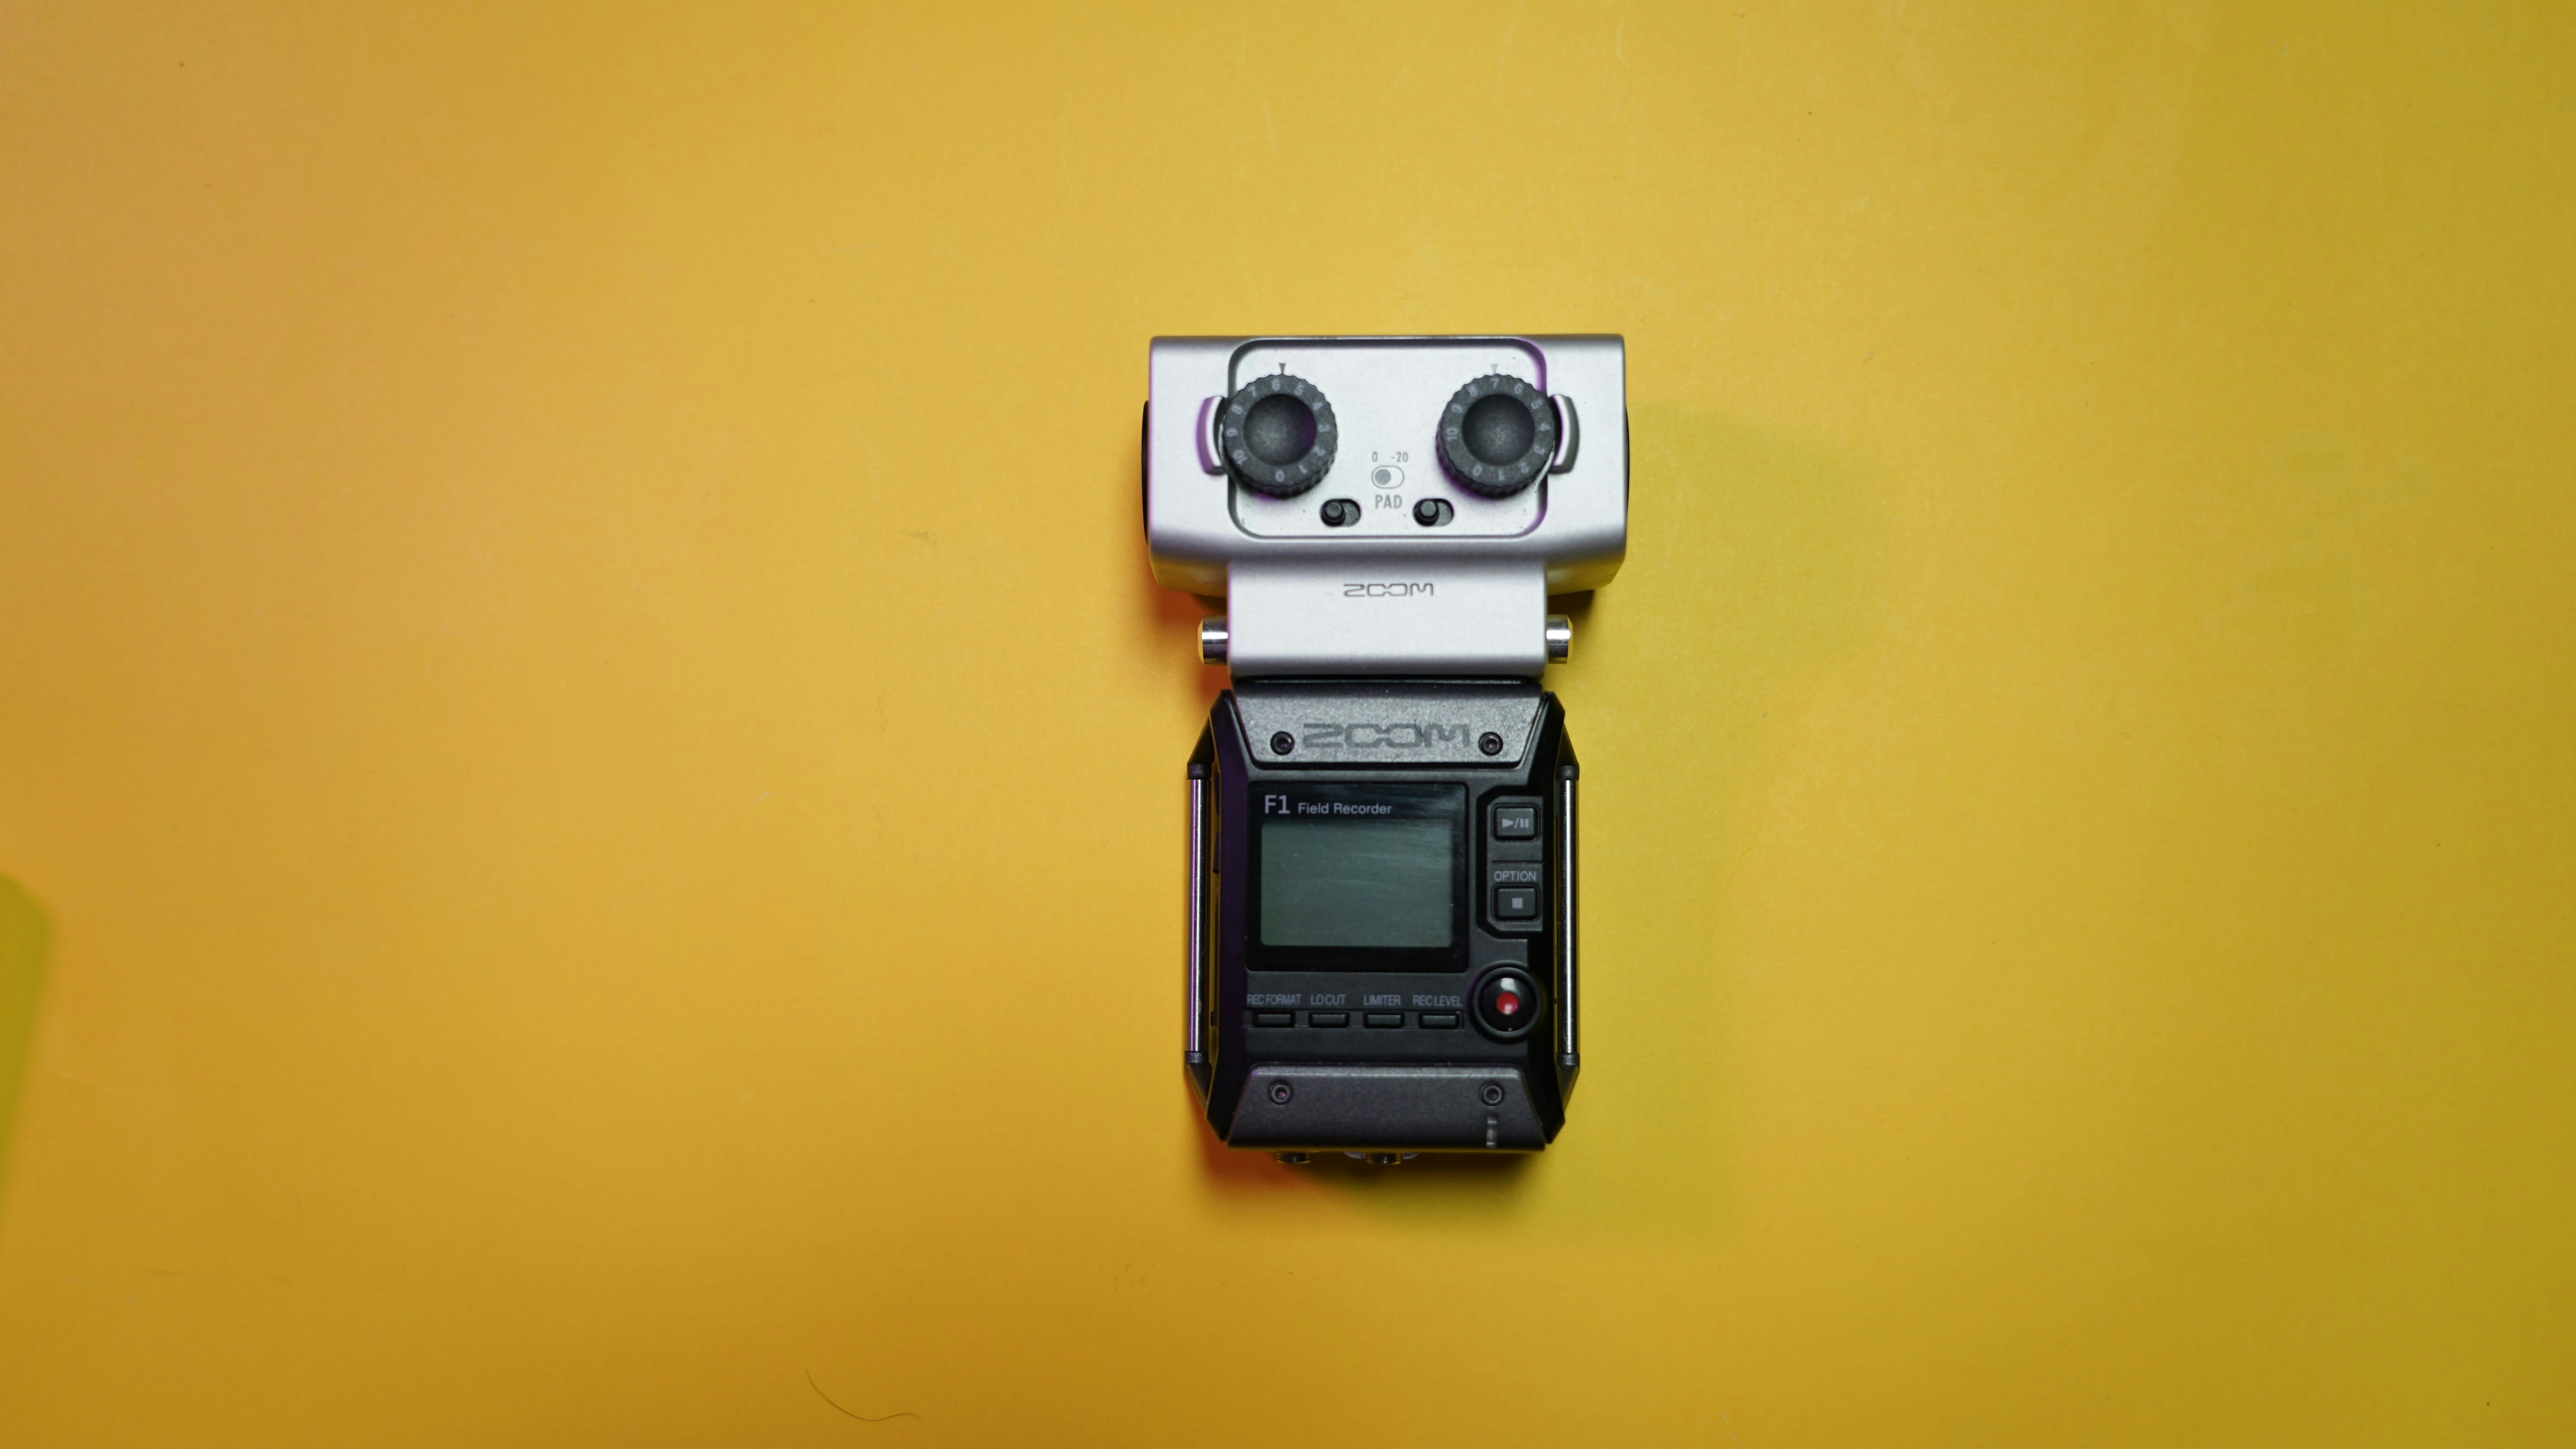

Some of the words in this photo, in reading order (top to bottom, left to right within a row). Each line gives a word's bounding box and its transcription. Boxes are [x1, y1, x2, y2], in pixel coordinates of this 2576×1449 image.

[1271, 379, 1280, 391] 6
[1294, 382, 1304, 395] 5
[1490, 377, 1500, 389] 7
[1514, 383, 1523, 394] 6
[1248, 386, 1256, 397] 7
[1467, 385, 1478, 397] 8
[1231, 404, 1243, 415] 8
[1451, 403, 1463, 413] 9
[1531, 399, 1543, 409] 5
[1226, 428, 1238, 437] 9
[1446, 427, 1457, 441] 10
[1312, 446, 1324, 456] 2
[1534, 446, 1545, 455] 3
[1233, 450, 1246, 465] 10
[1372, 452, 1378, 462] 0
[1391, 452, 1409, 462] -20
[1298, 463, 1308, 475] 1
[1472, 465, 1482, 476] 0
[1518, 463, 1529, 474] 2
[1276, 470, 1285, 482] 0
[1498, 470, 1504, 481] 1
[1375, 494, 1402, 509] PAD
[1343, 583, 1434, 597] ZOOM
[1303, 723, 1470, 748] ZOOM
[1265, 795, 1290, 814] F1
[1298, 803, 1329, 814] Field
[1334, 803, 1392, 814] Recorder
[1494, 870, 1537, 882] OPTION
[1247, 994, 1264, 1004] REC
[1266, 994, 1302, 1004] FORMAT
[1311, 994, 1324, 1005] LO
[1325, 994, 1346, 1005] CUT
[1364, 994, 1401, 1006] LIMITER
[1413, 994, 1432, 1006] REC
[1434, 995, 1463, 1006] LEVEL
